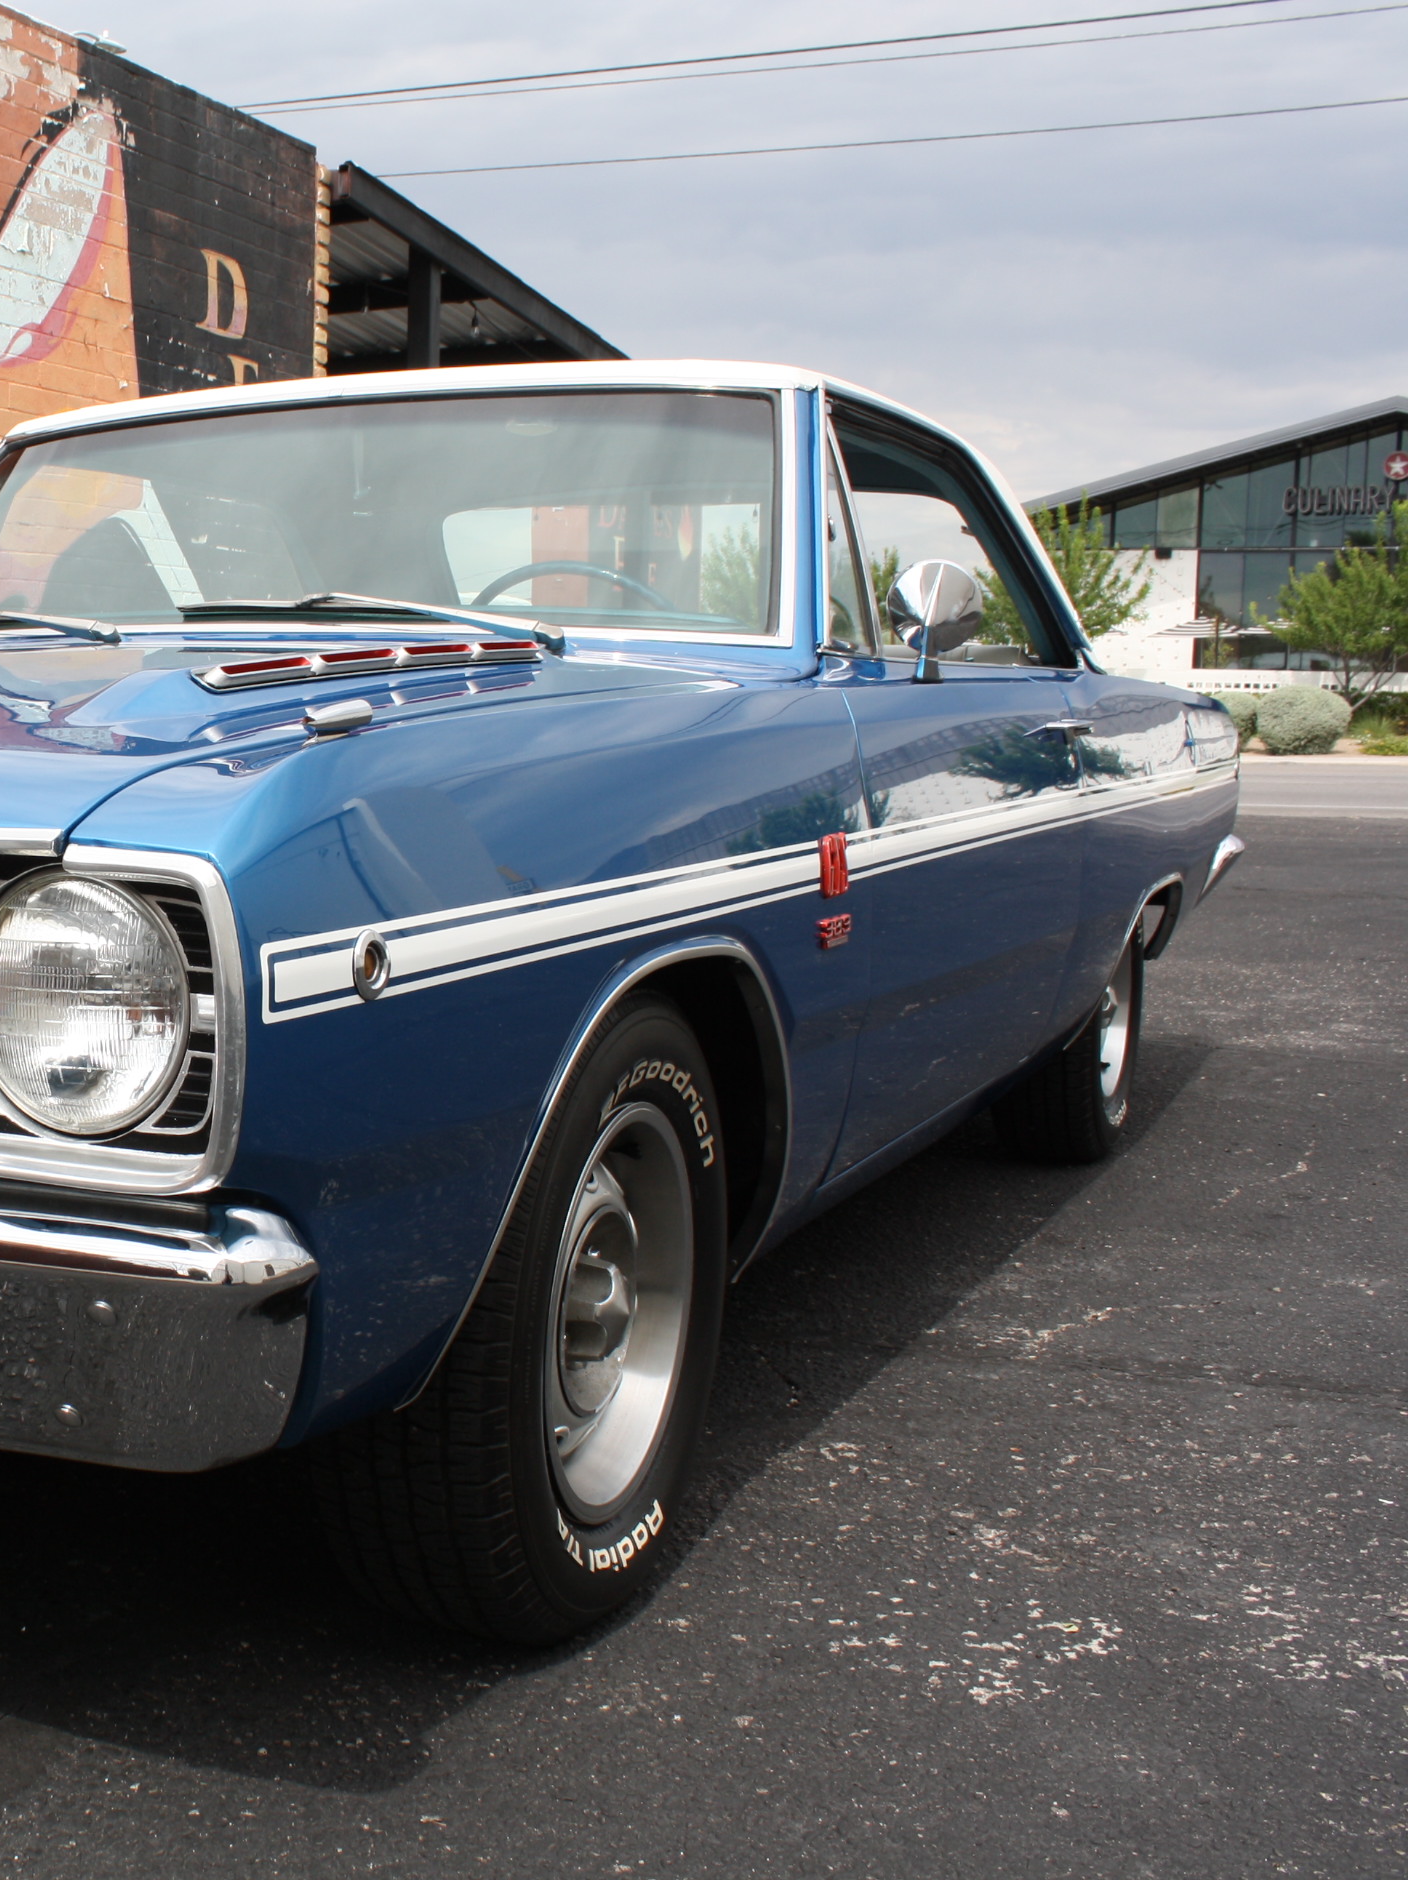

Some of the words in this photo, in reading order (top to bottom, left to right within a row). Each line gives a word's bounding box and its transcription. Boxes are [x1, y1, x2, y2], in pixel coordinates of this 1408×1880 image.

[195, 249, 248, 339] D
[1282, 484, 1396, 517] CULINARY
[588, 1499, 664, 1573] Radial
